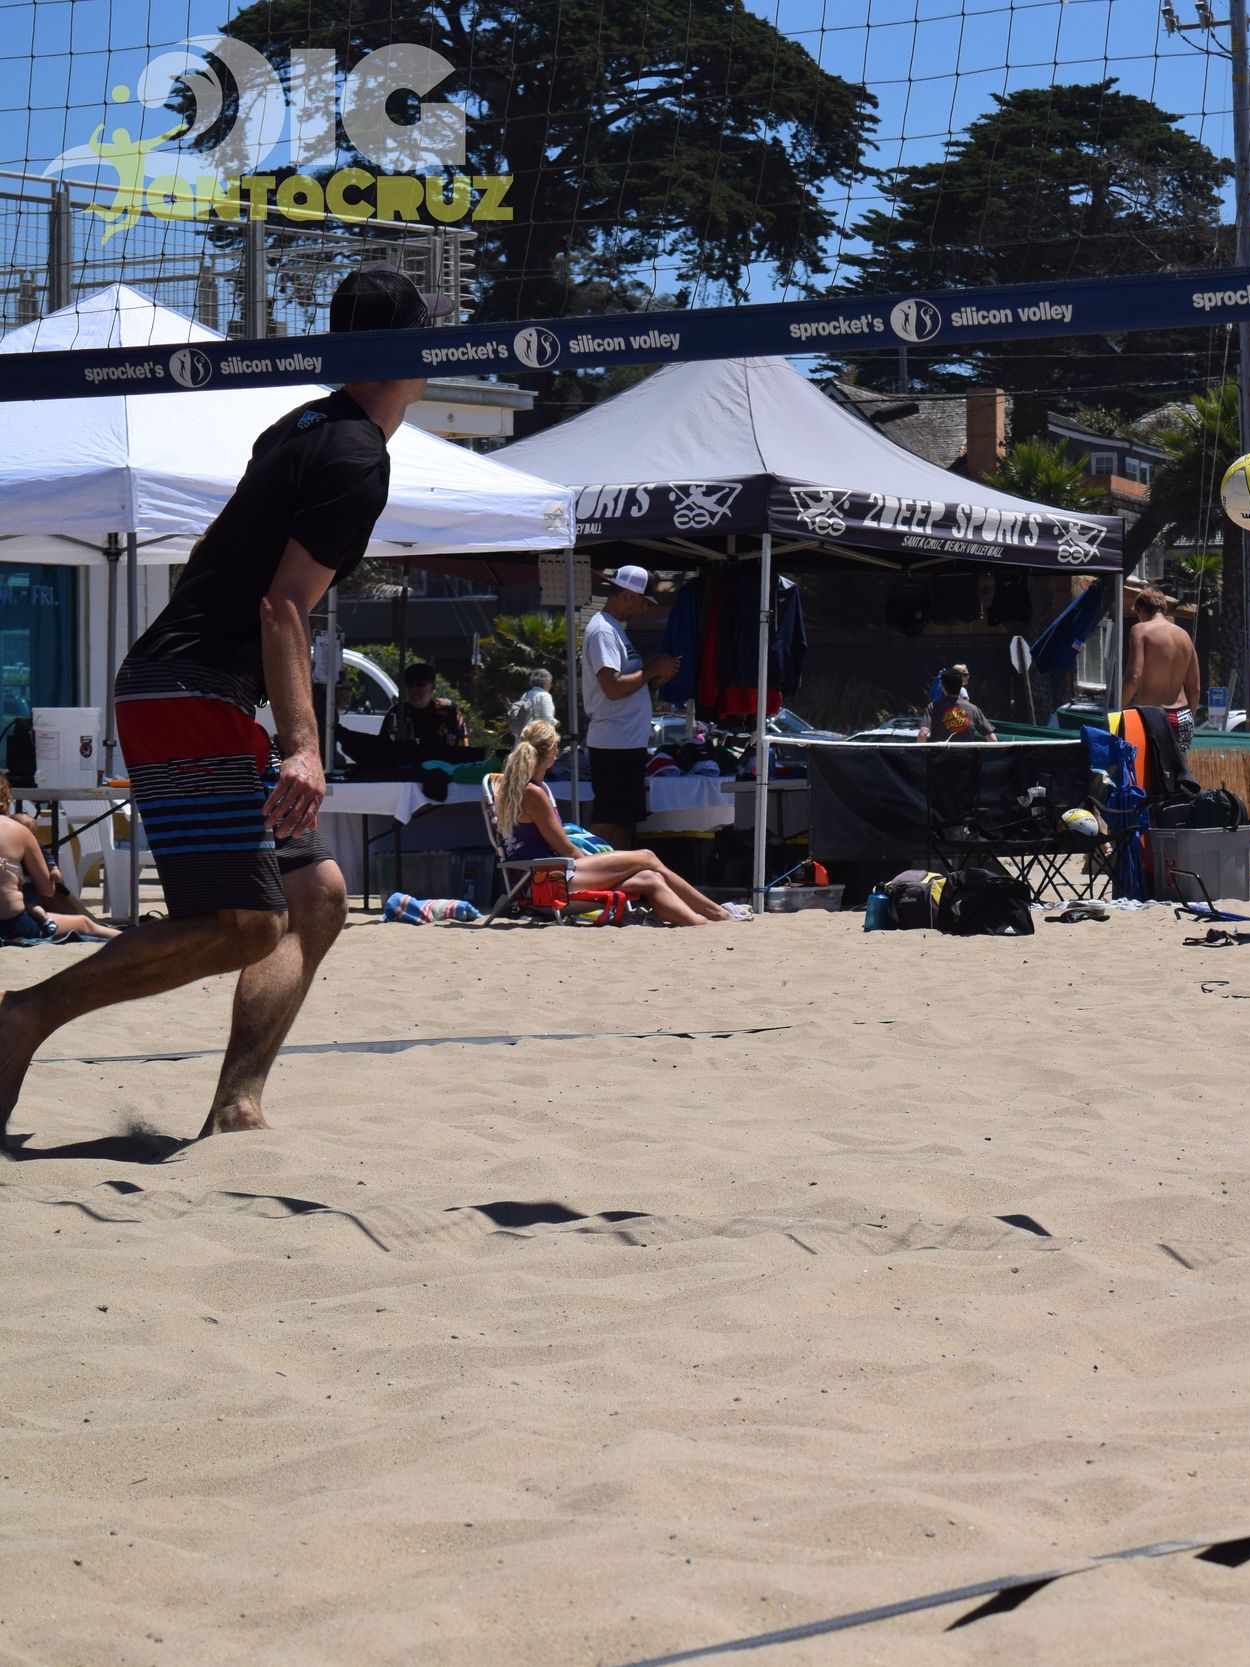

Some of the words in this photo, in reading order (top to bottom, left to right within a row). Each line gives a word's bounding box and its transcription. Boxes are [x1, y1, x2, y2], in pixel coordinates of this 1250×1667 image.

[789, 314, 885, 340] sprocket's
[951, 306, 1013, 327] silicon
[1017, 301, 1073, 323] volley
[421, 341, 509, 366] sprocket's
[568, 334, 626, 354] silicon
[630, 330, 680, 350] volley
[84, 361, 165, 384] sprocket's
[220, 356, 272, 375] silicon
[276, 353, 322, 373] volley
[573, 483, 656, 520] ORTS
[862, 492, 946, 535] 2DEEP
[951, 503, 1043, 547] SPORTS
[575, 522, 602, 535] EYBALL
[901, 535, 924, 550] SANTA
[923, 537, 945, 551] CRUZ
[943, 540, 967, 553] BEACH
[965, 542, 1004, 558] VOLLEYBALL
